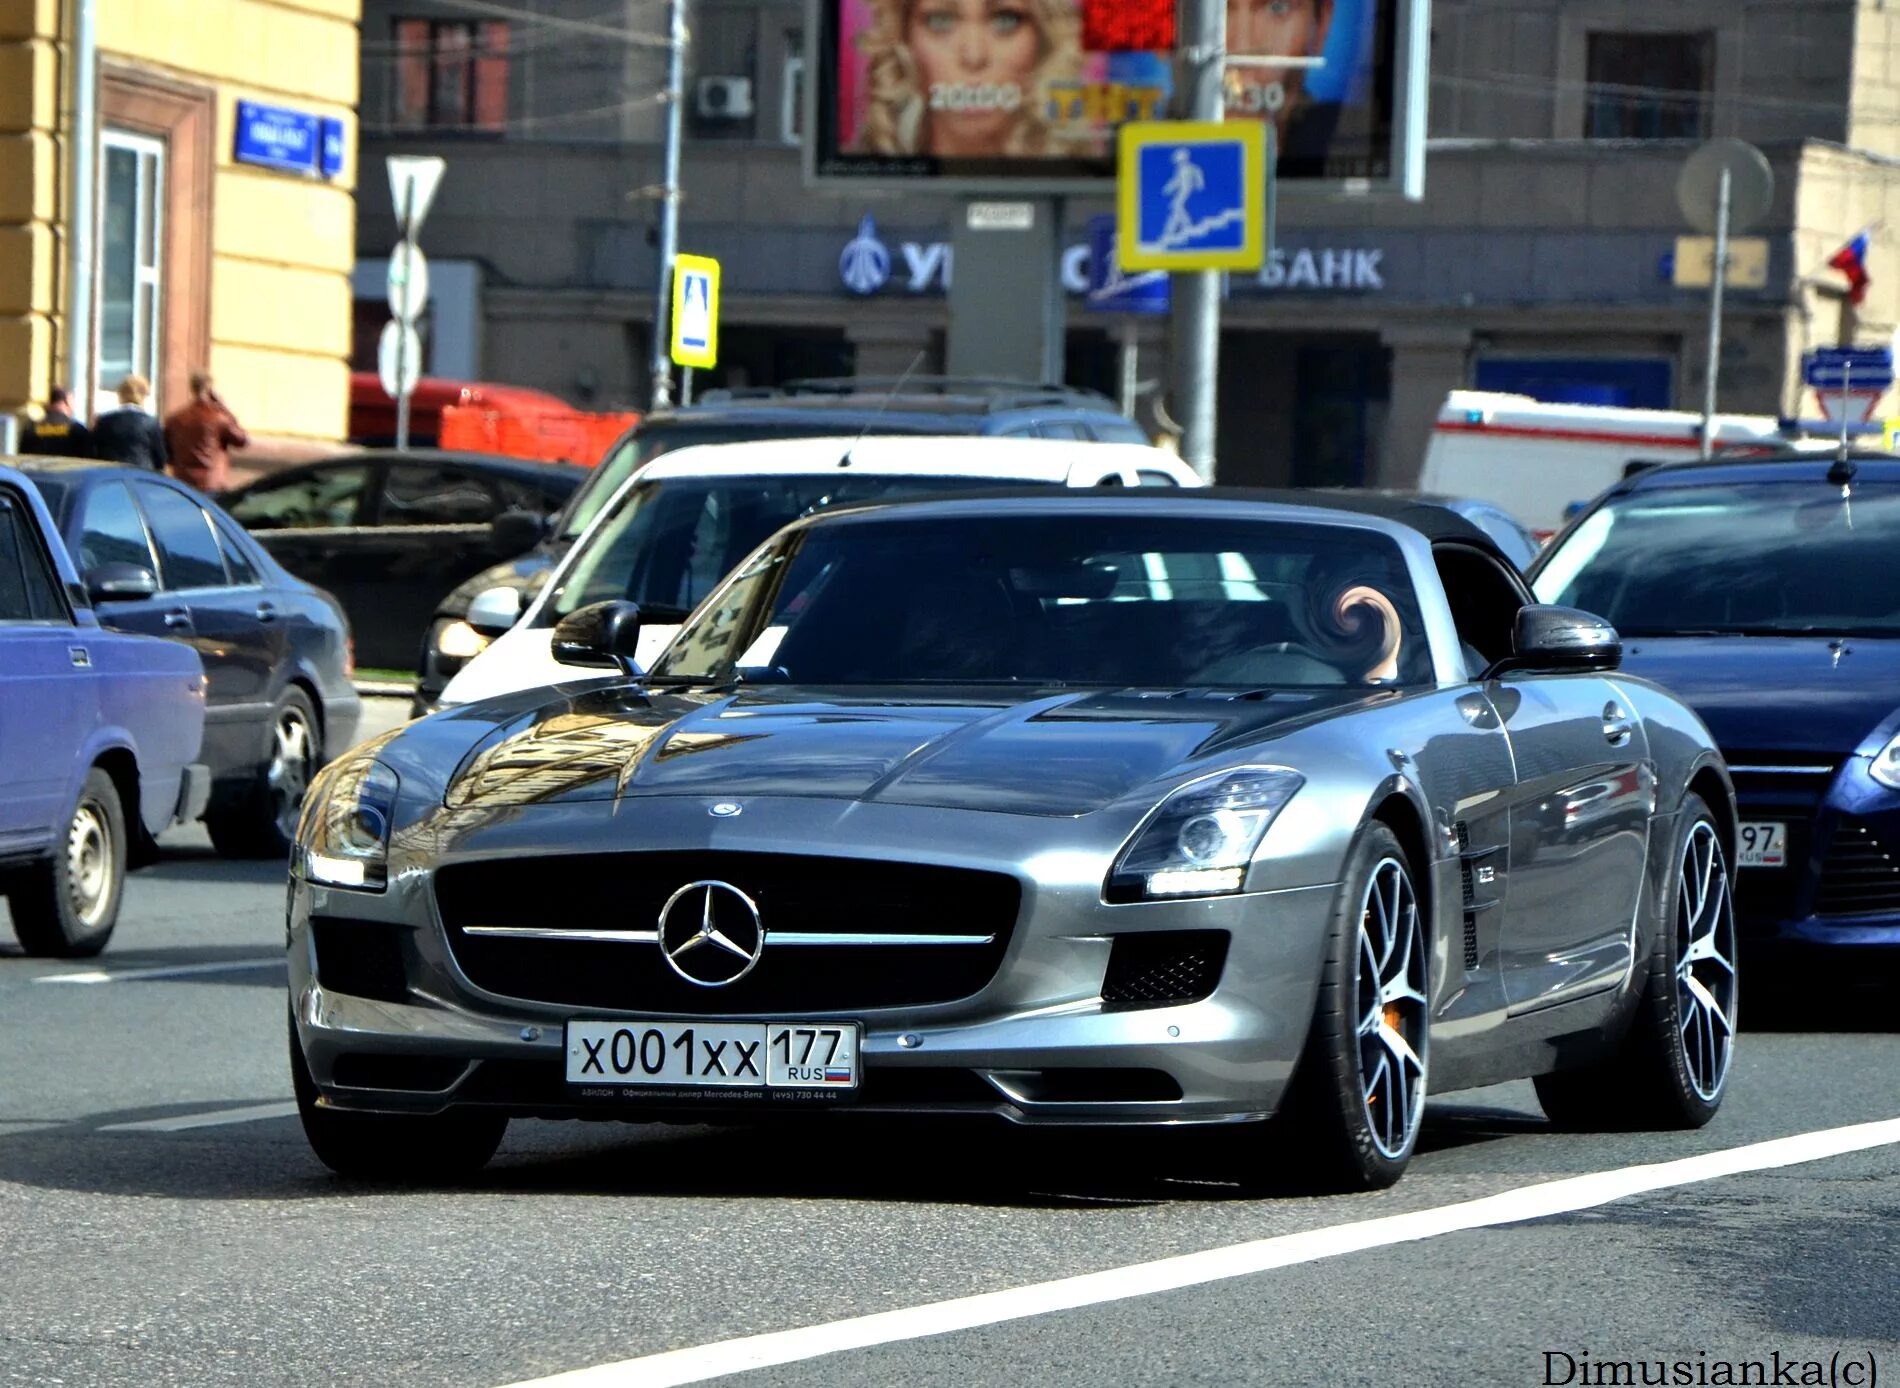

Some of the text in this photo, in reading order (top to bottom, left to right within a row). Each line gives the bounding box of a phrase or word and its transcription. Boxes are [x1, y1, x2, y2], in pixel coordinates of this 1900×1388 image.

[1258, 248, 1384, 289] БАНК
[1742, 826, 1775, 851] 97
[773, 1029, 843, 1066] 177
[788, 1067, 823, 1081] RUS
[704, 1090, 763, 1099] Mercedes-Benz
[772, 1091, 837, 1100] (495) 730 44 44
